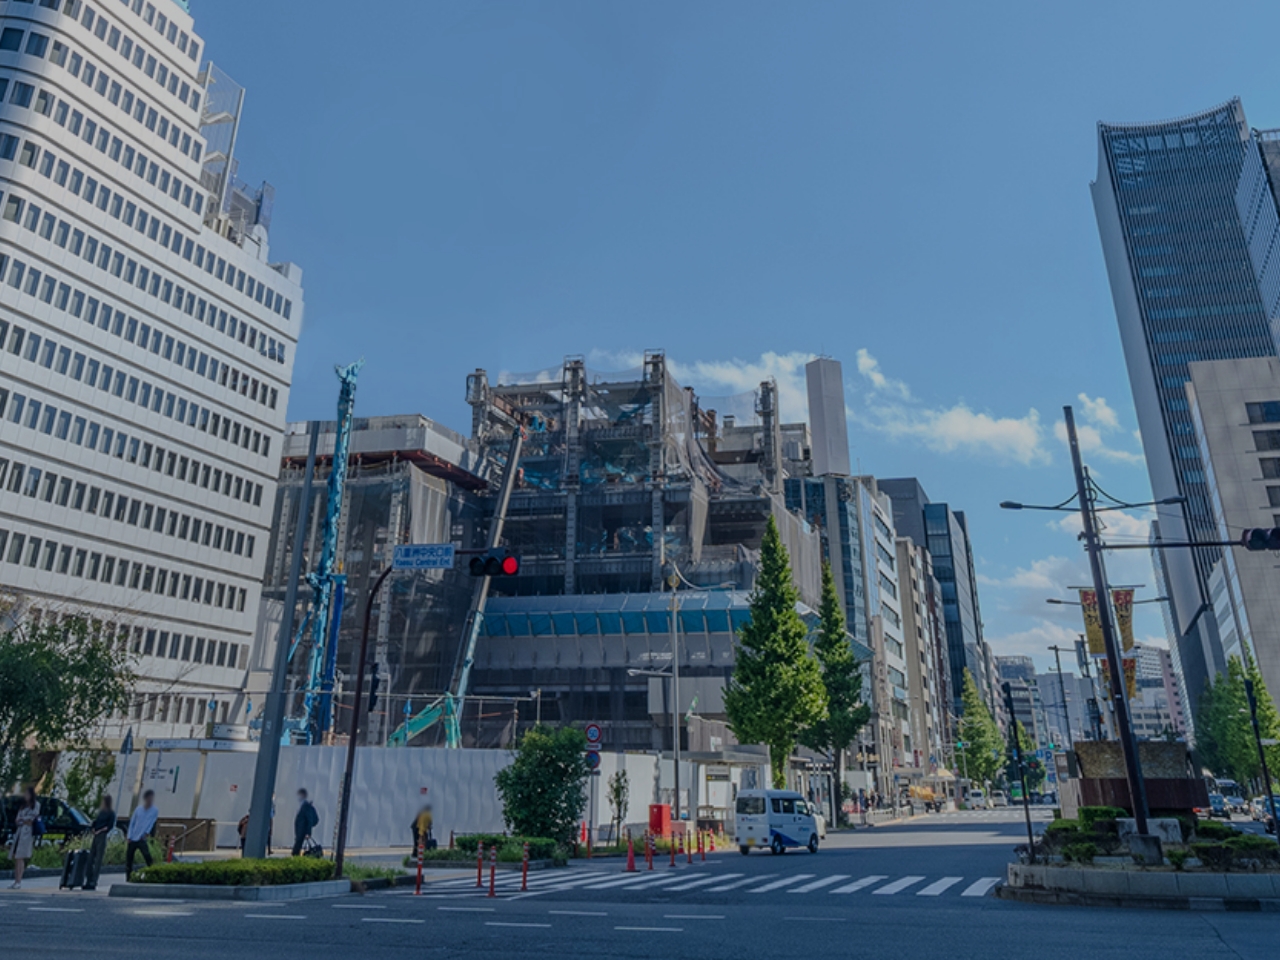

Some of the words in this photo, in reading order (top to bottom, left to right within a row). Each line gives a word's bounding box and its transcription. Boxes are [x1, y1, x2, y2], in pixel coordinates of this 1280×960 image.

[395, 546, 452, 558] 八重洲中央口前
